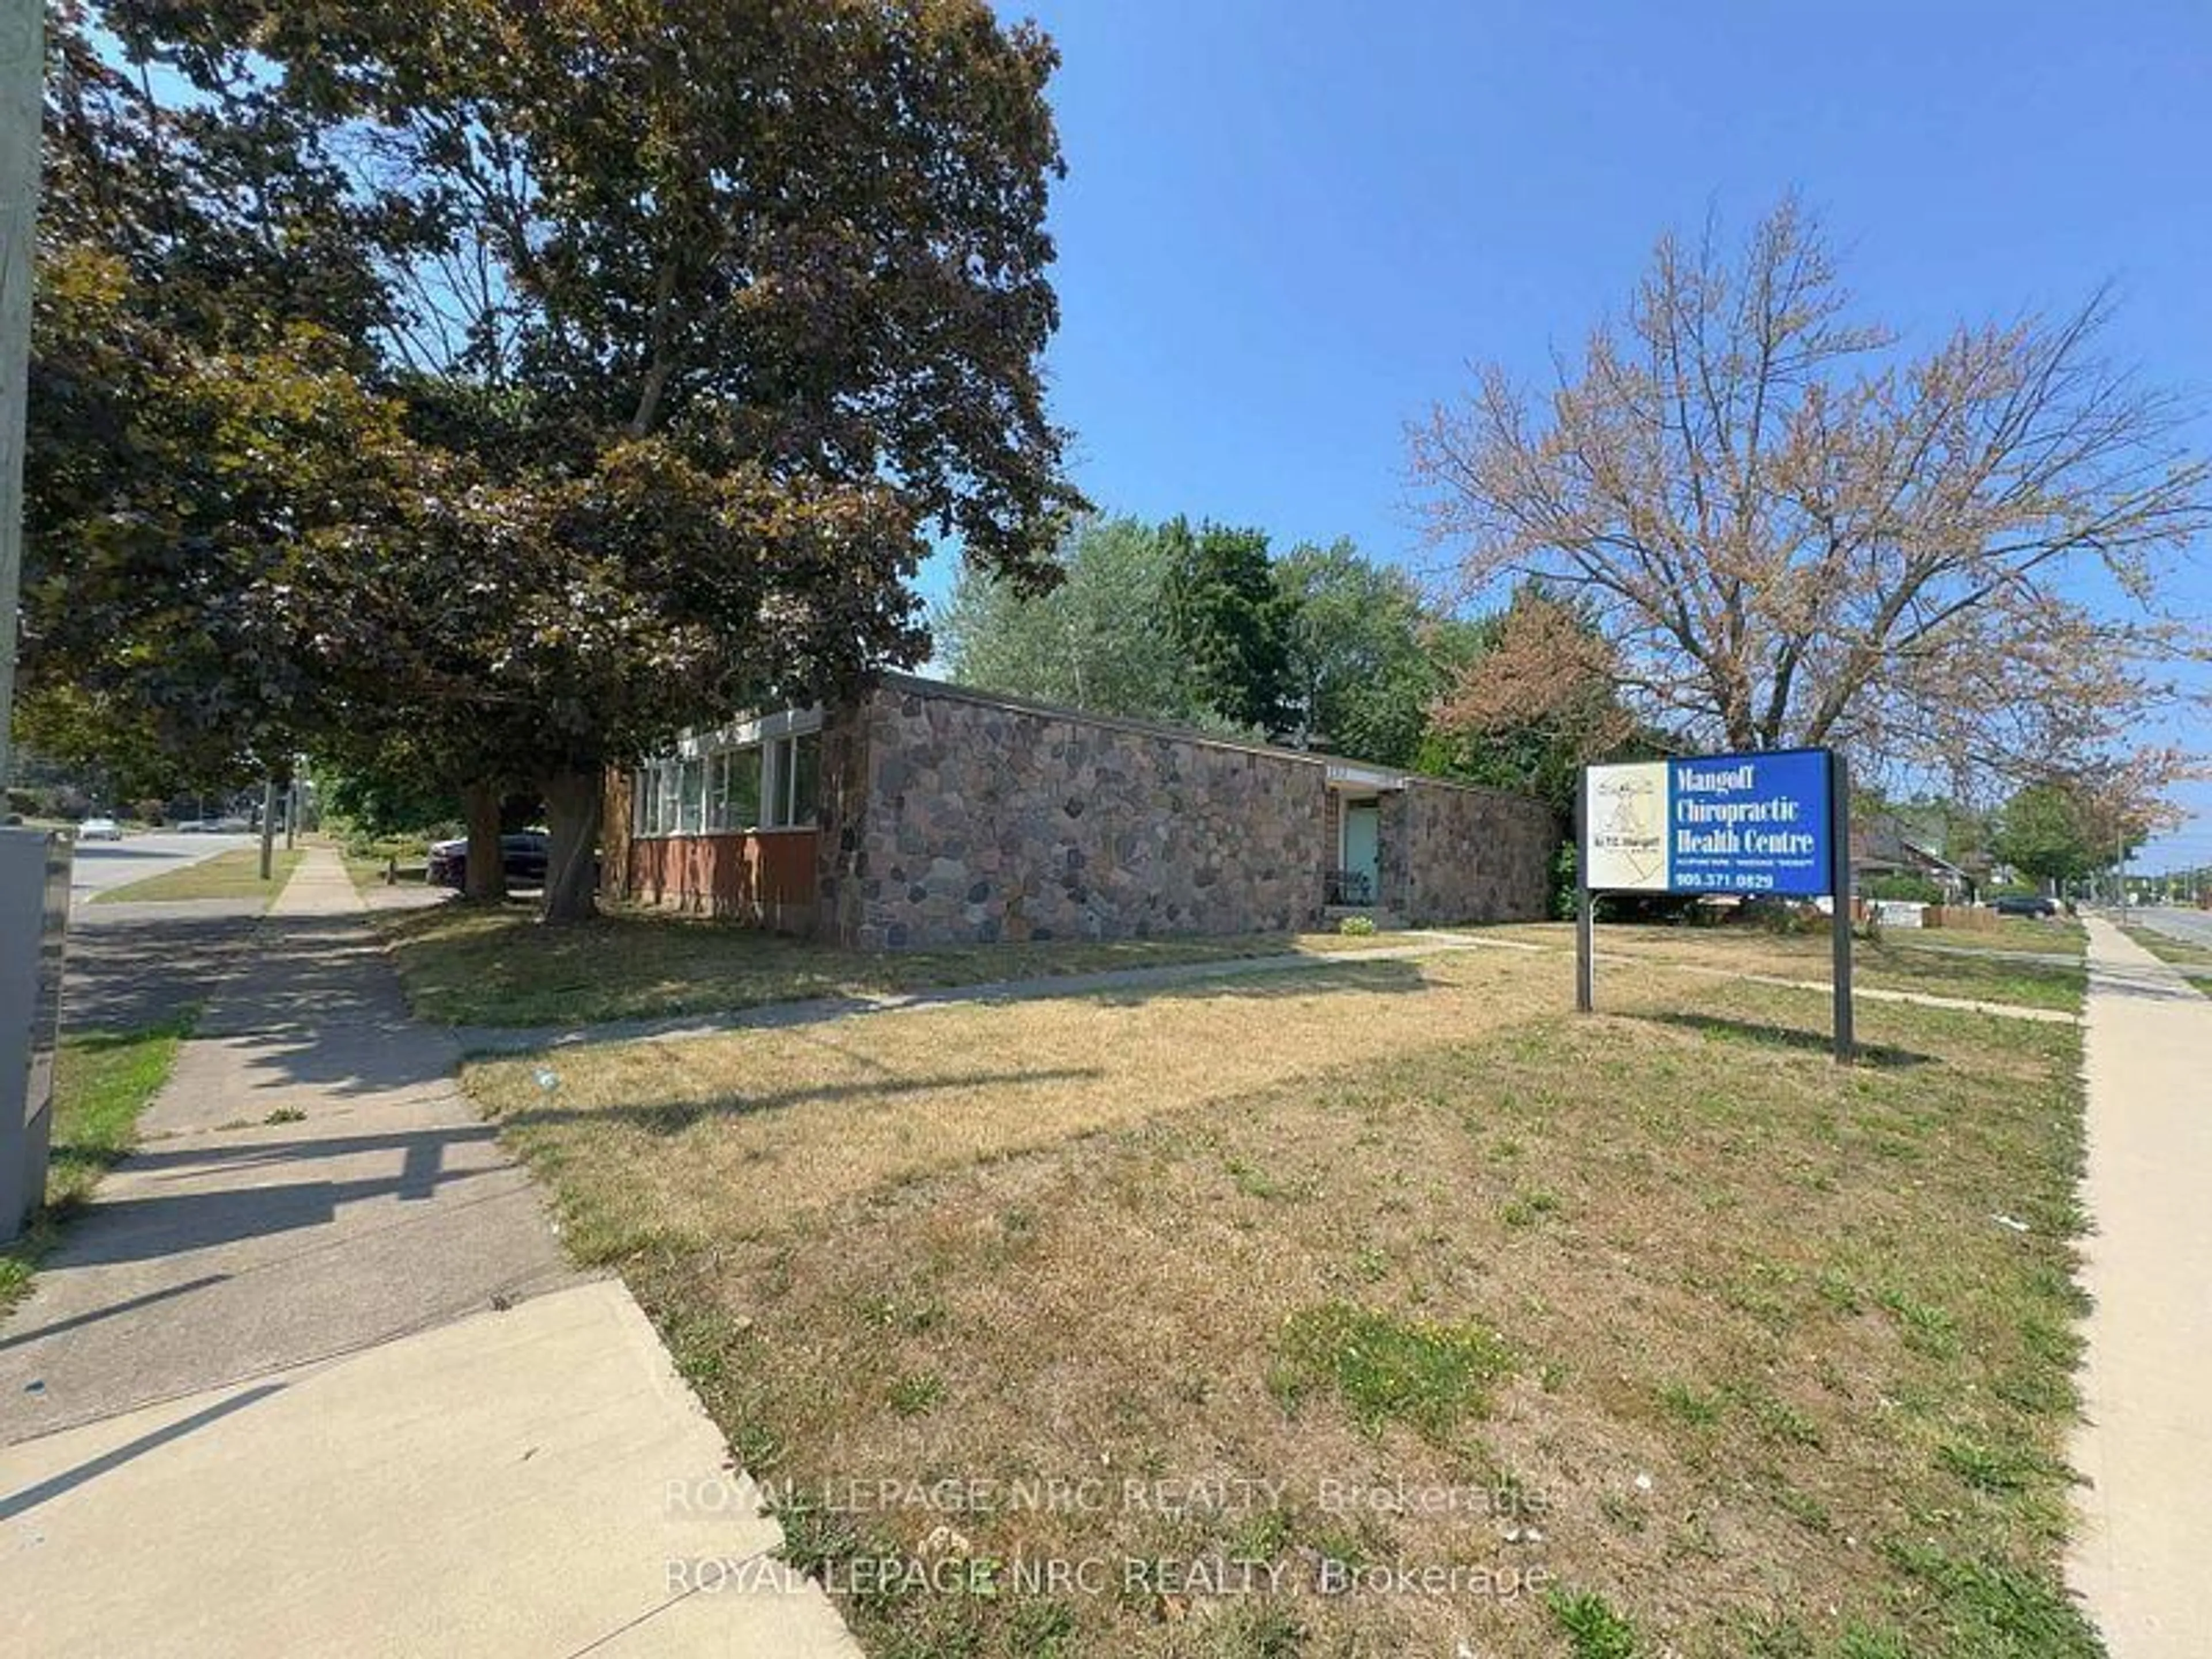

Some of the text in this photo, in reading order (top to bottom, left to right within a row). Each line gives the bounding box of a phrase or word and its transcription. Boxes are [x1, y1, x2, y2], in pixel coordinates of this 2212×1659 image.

[1677, 764, 1755, 794] Mangoff
[1677, 796, 1800, 828] Chiropractic
[1677, 828, 1740, 854] Health
[1744, 828, 1815, 854] Centre
